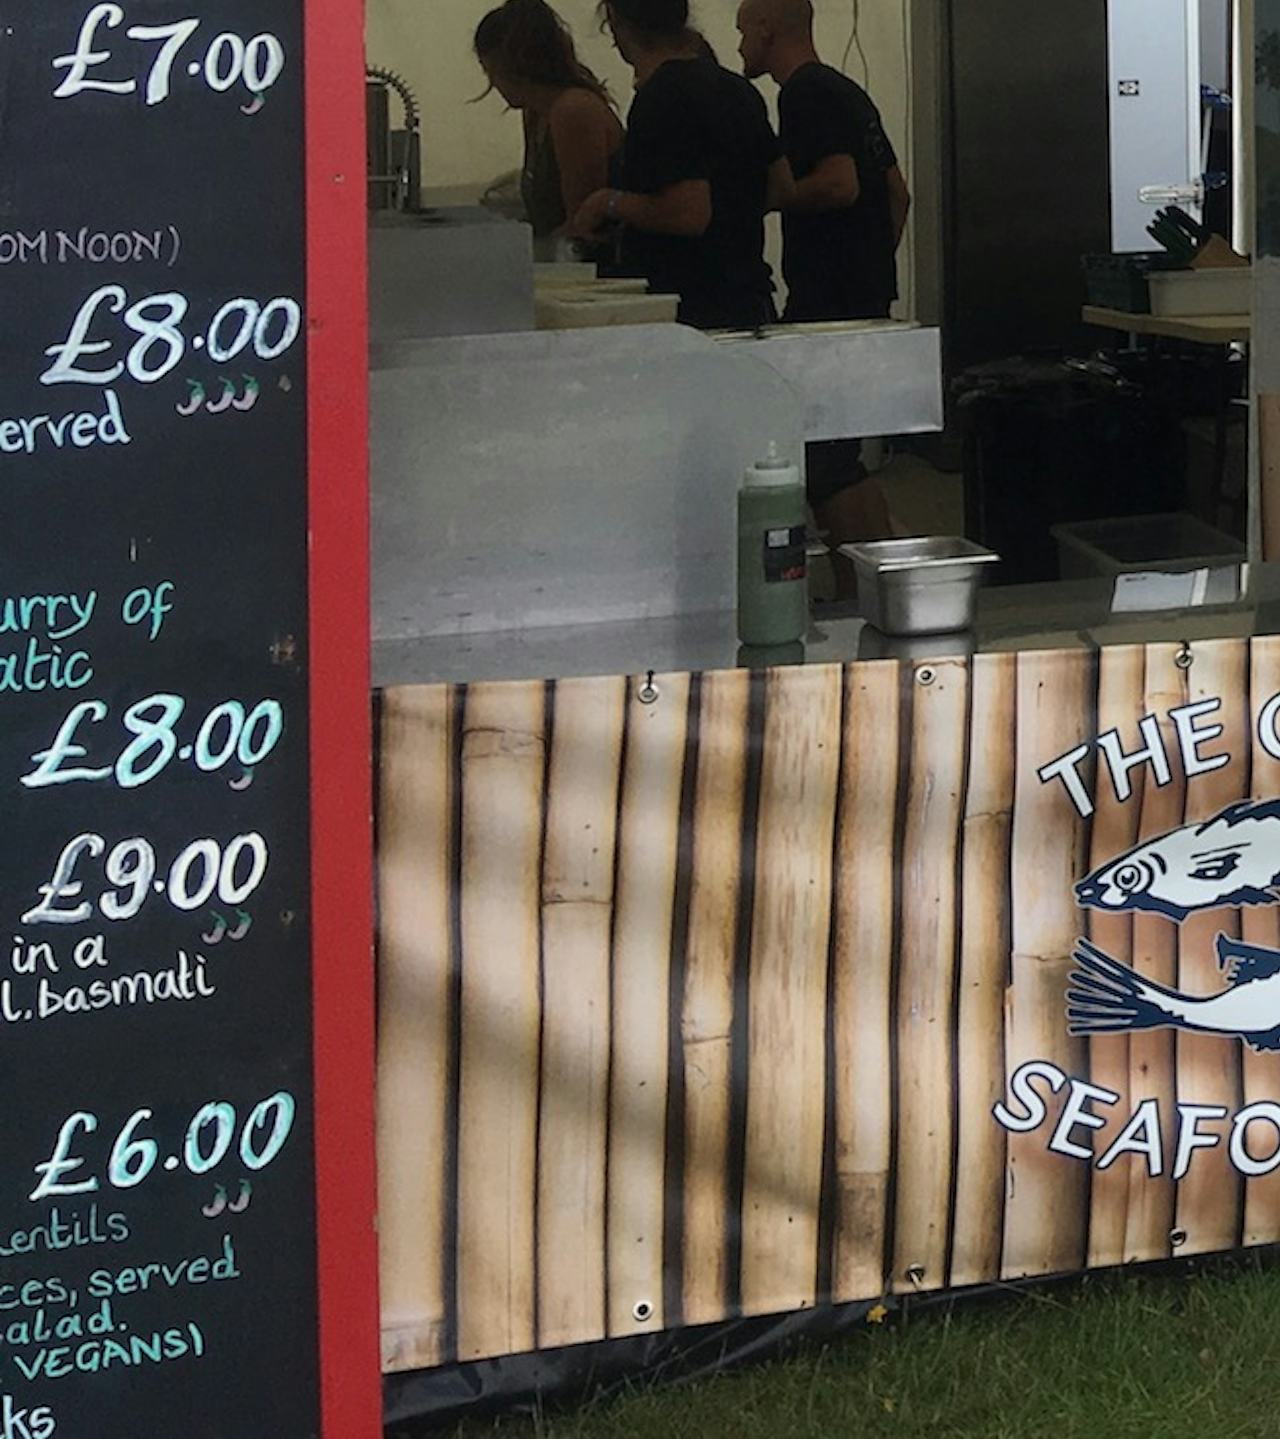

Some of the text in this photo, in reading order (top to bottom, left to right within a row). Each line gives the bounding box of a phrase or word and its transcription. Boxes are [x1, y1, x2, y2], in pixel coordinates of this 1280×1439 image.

[52, 2, 285, 105] £7.00
[39, 284, 301, 386] £8.00
[121, 581, 176, 642] of
[20, 693, 283, 789] £8.00
[1039, 698, 1231, 819] THE
[21, 832, 268, 925] £9.00
[12, 934, 109, 973] in a
[28, 1091, 296, 1201] £6.00
[87, 1234, 240, 1298] served
[0, 1298, 129, 1345] alad.
